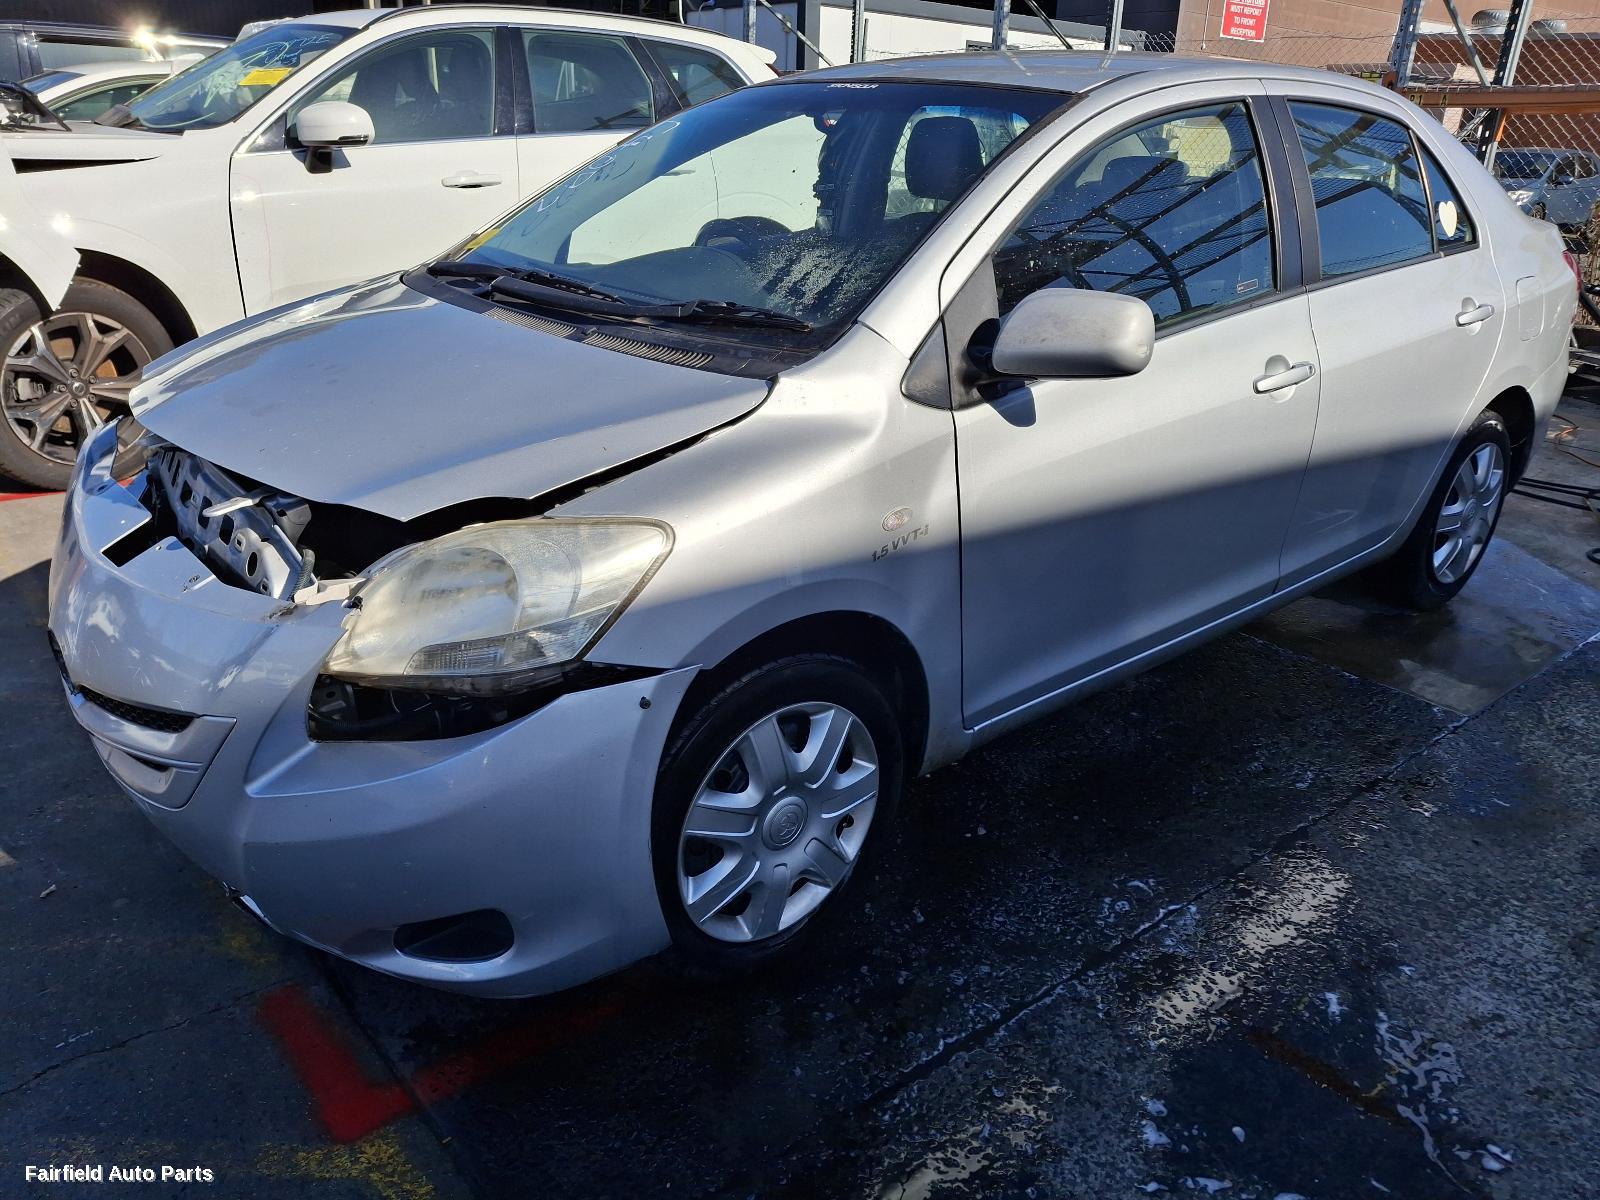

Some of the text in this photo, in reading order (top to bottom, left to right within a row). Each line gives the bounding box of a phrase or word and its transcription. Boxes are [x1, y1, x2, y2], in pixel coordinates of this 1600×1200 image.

[1230, 5, 1262, 16] MUST REPORT
[1234, 16, 1256, 26] TO FRONT
[1230, 27, 1256, 37] RECEPTION
[872, 524, 929, 562] 1.5 VVT-i
